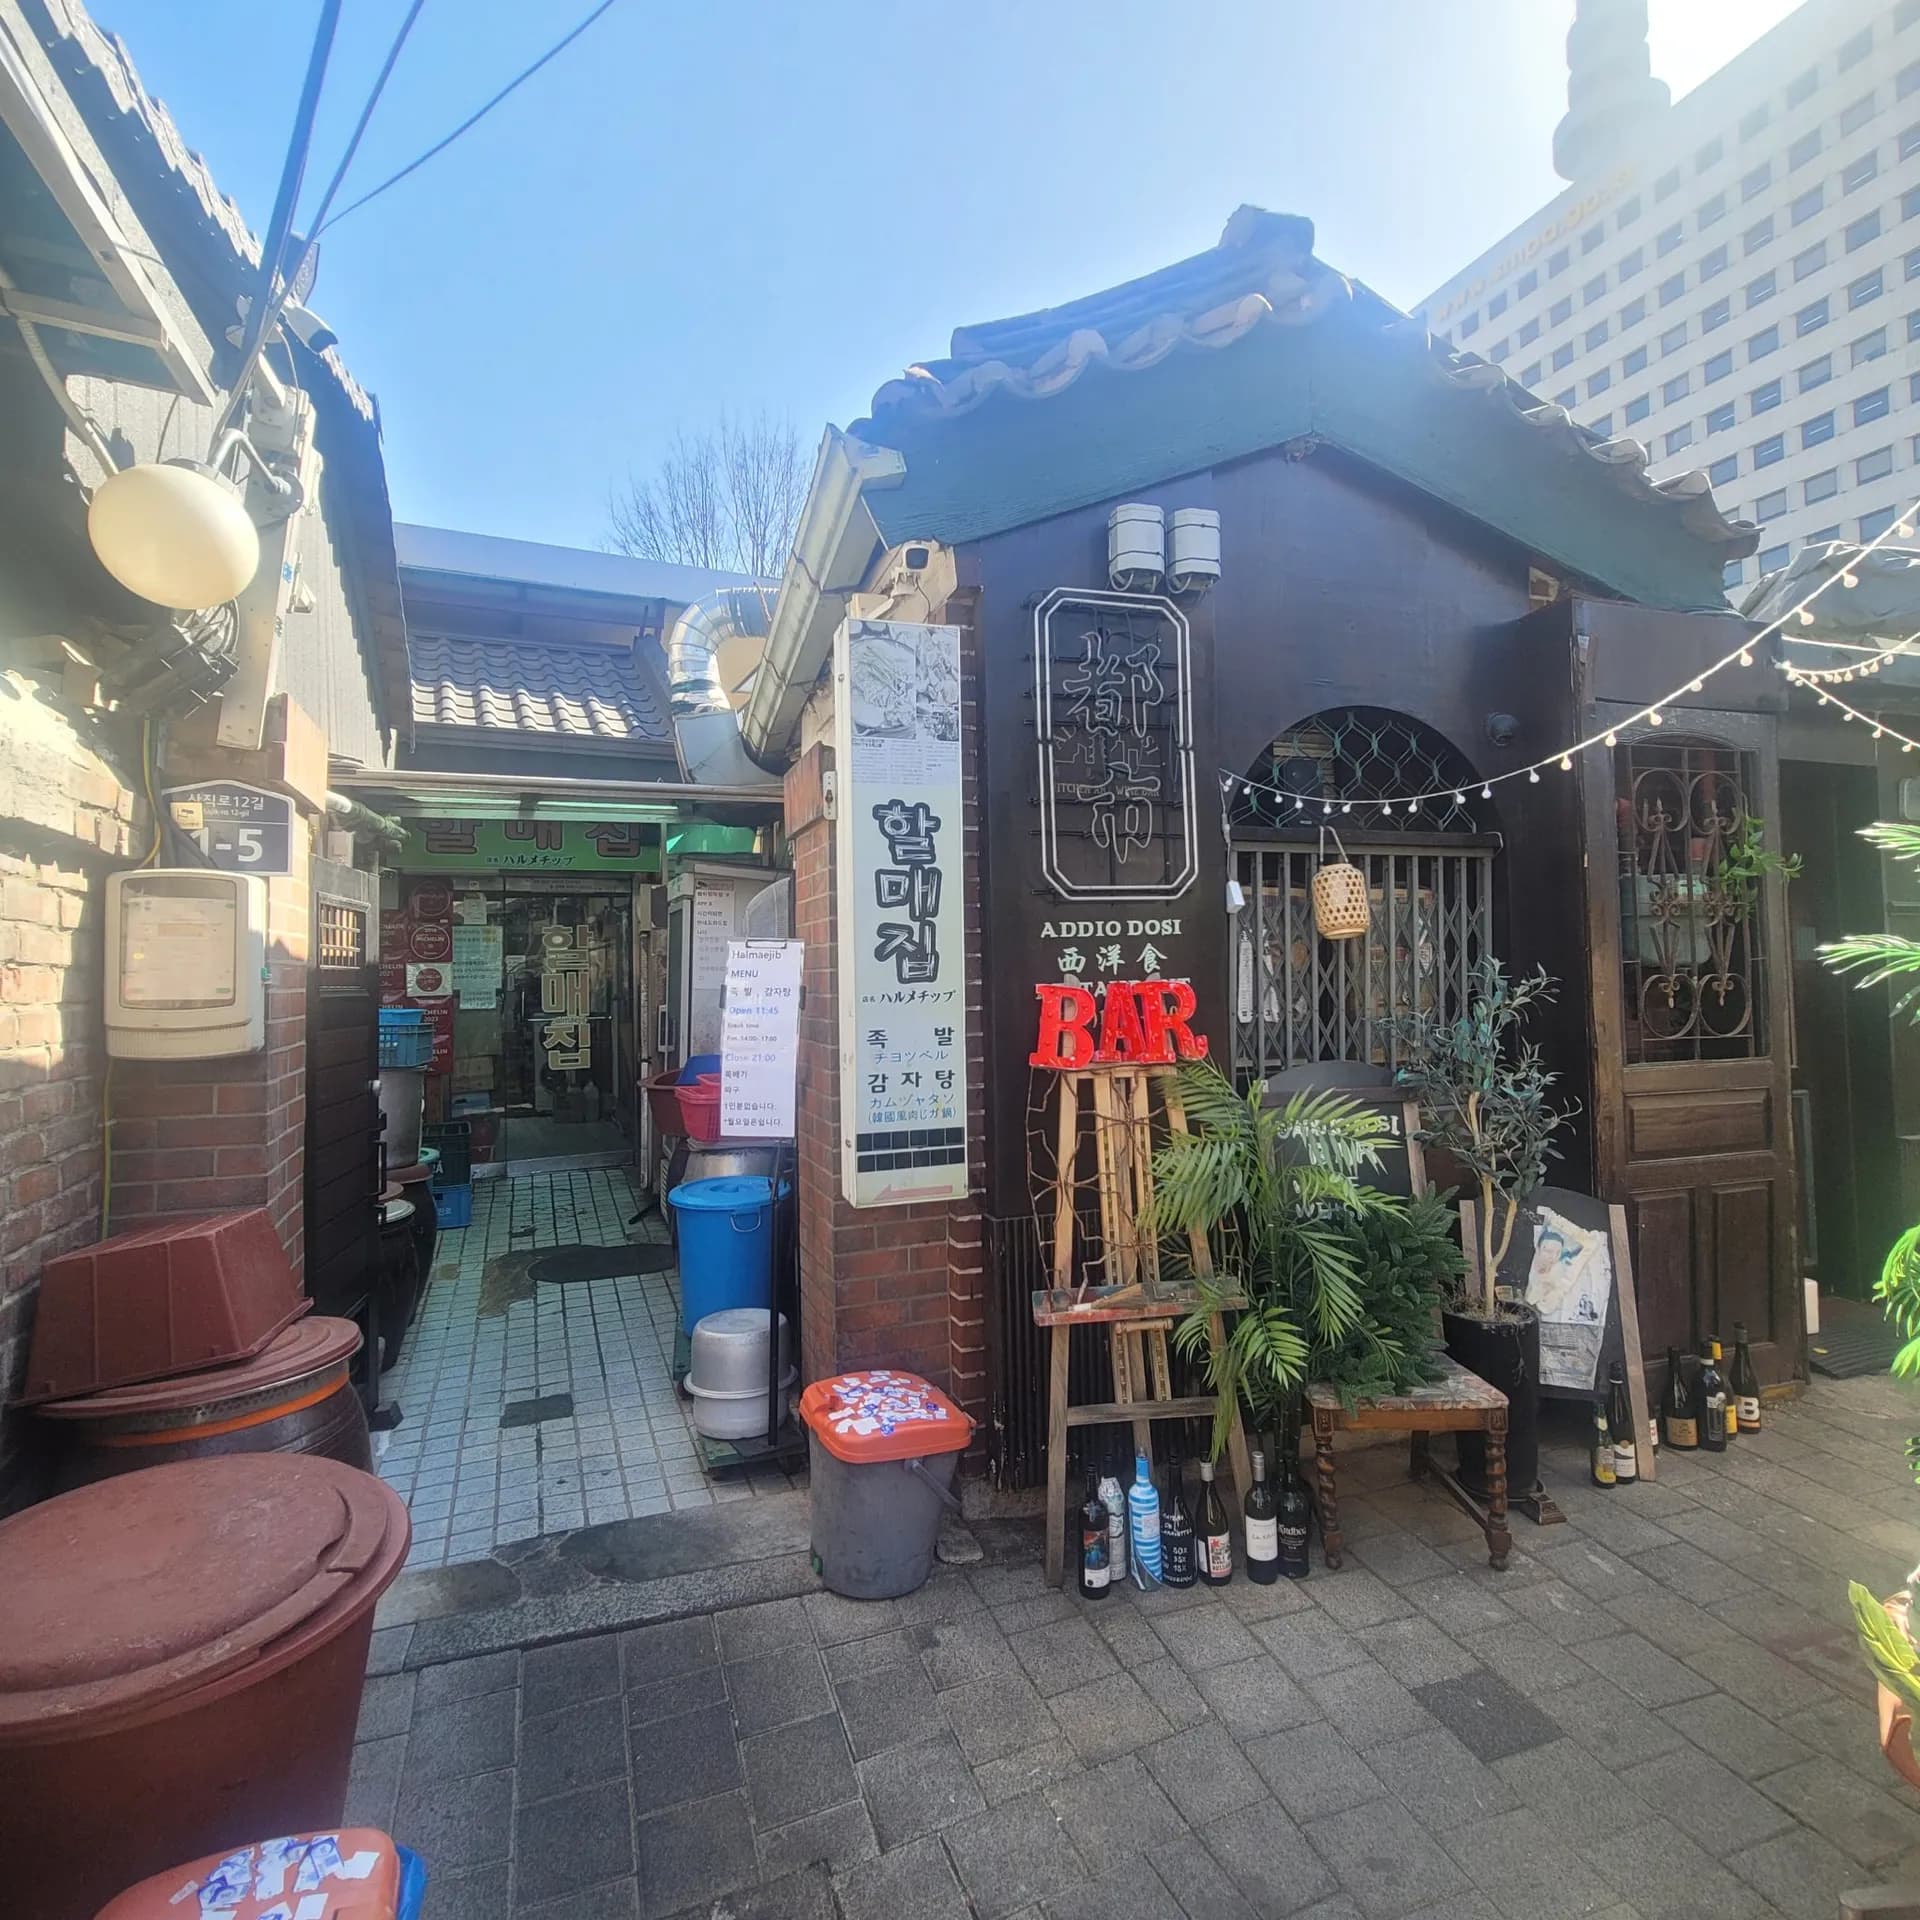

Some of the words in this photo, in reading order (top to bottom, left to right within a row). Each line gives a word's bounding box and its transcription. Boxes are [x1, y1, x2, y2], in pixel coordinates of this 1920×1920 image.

[190, 827, 264, 862] 1-5
[872, 798, 943, 984] 할매집
[1040, 920, 1122, 939] ADDIO
[1127, 919, 1183, 936] DOSI
[732, 950, 782, 962] Halmaejib
[1057, 942, 1168, 976] 西洋食
[731, 969, 759, 978] MENU
[541, 924, 594, 1071] 할매집
[1029, 979, 1209, 1070] BAR
